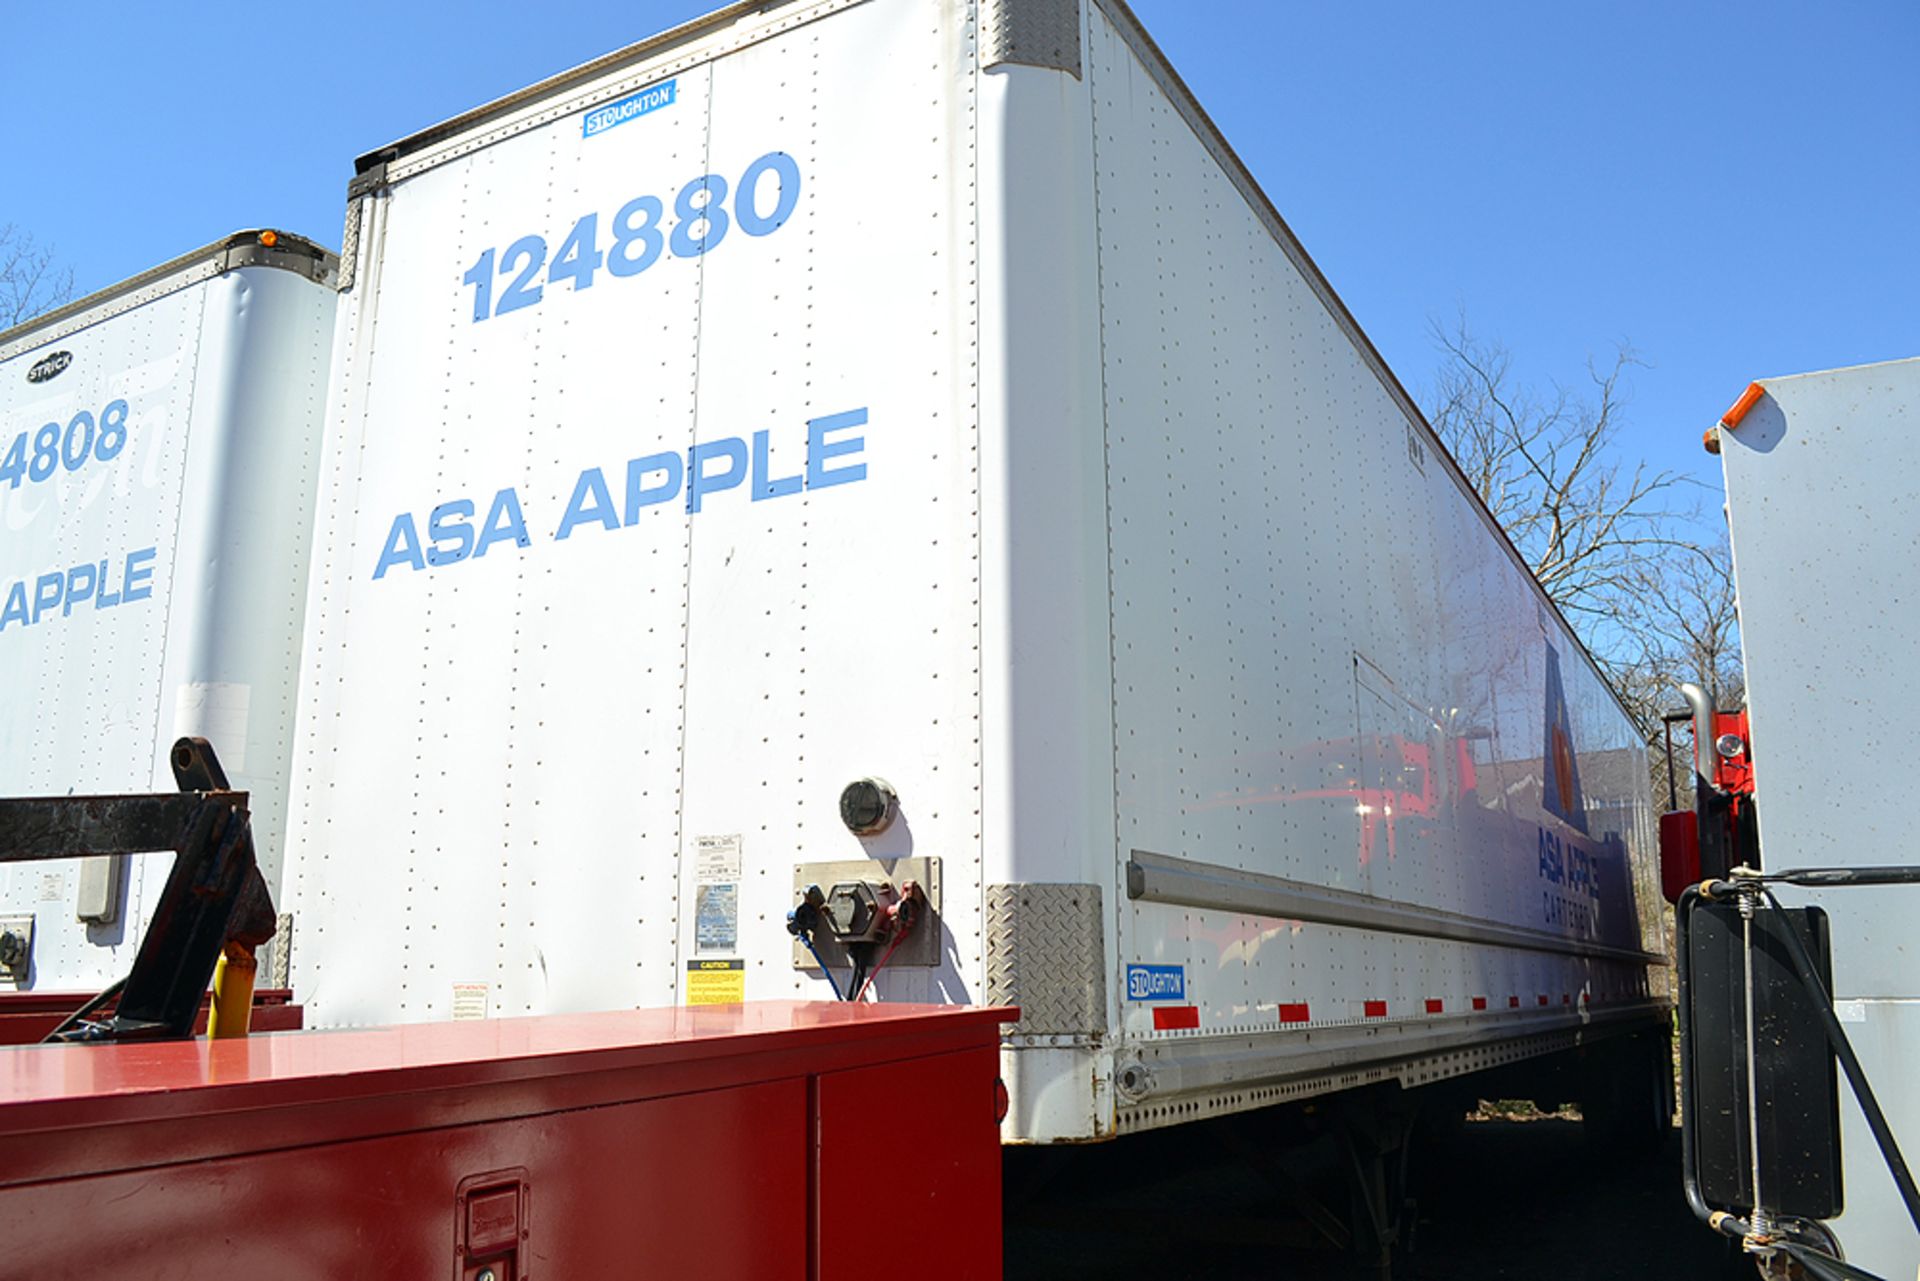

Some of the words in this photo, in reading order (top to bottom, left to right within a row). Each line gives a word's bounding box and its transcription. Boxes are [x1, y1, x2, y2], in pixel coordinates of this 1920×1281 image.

[586, 87, 670, 135] STOUGHTON
[462, 150, 801, 324] 124880
[29, 355, 71, 381] STRICK
[372, 486, 531, 581] ASA
[554, 407, 869, 540] APPLE
[0, 546, 158, 632] APPLE
[1539, 827, 1566, 886] ASA
[1567, 843, 1600, 899] APPLE
[699, 961, 731, 970] CAUTION
[1129, 968, 1182, 998] STOUGHTON
